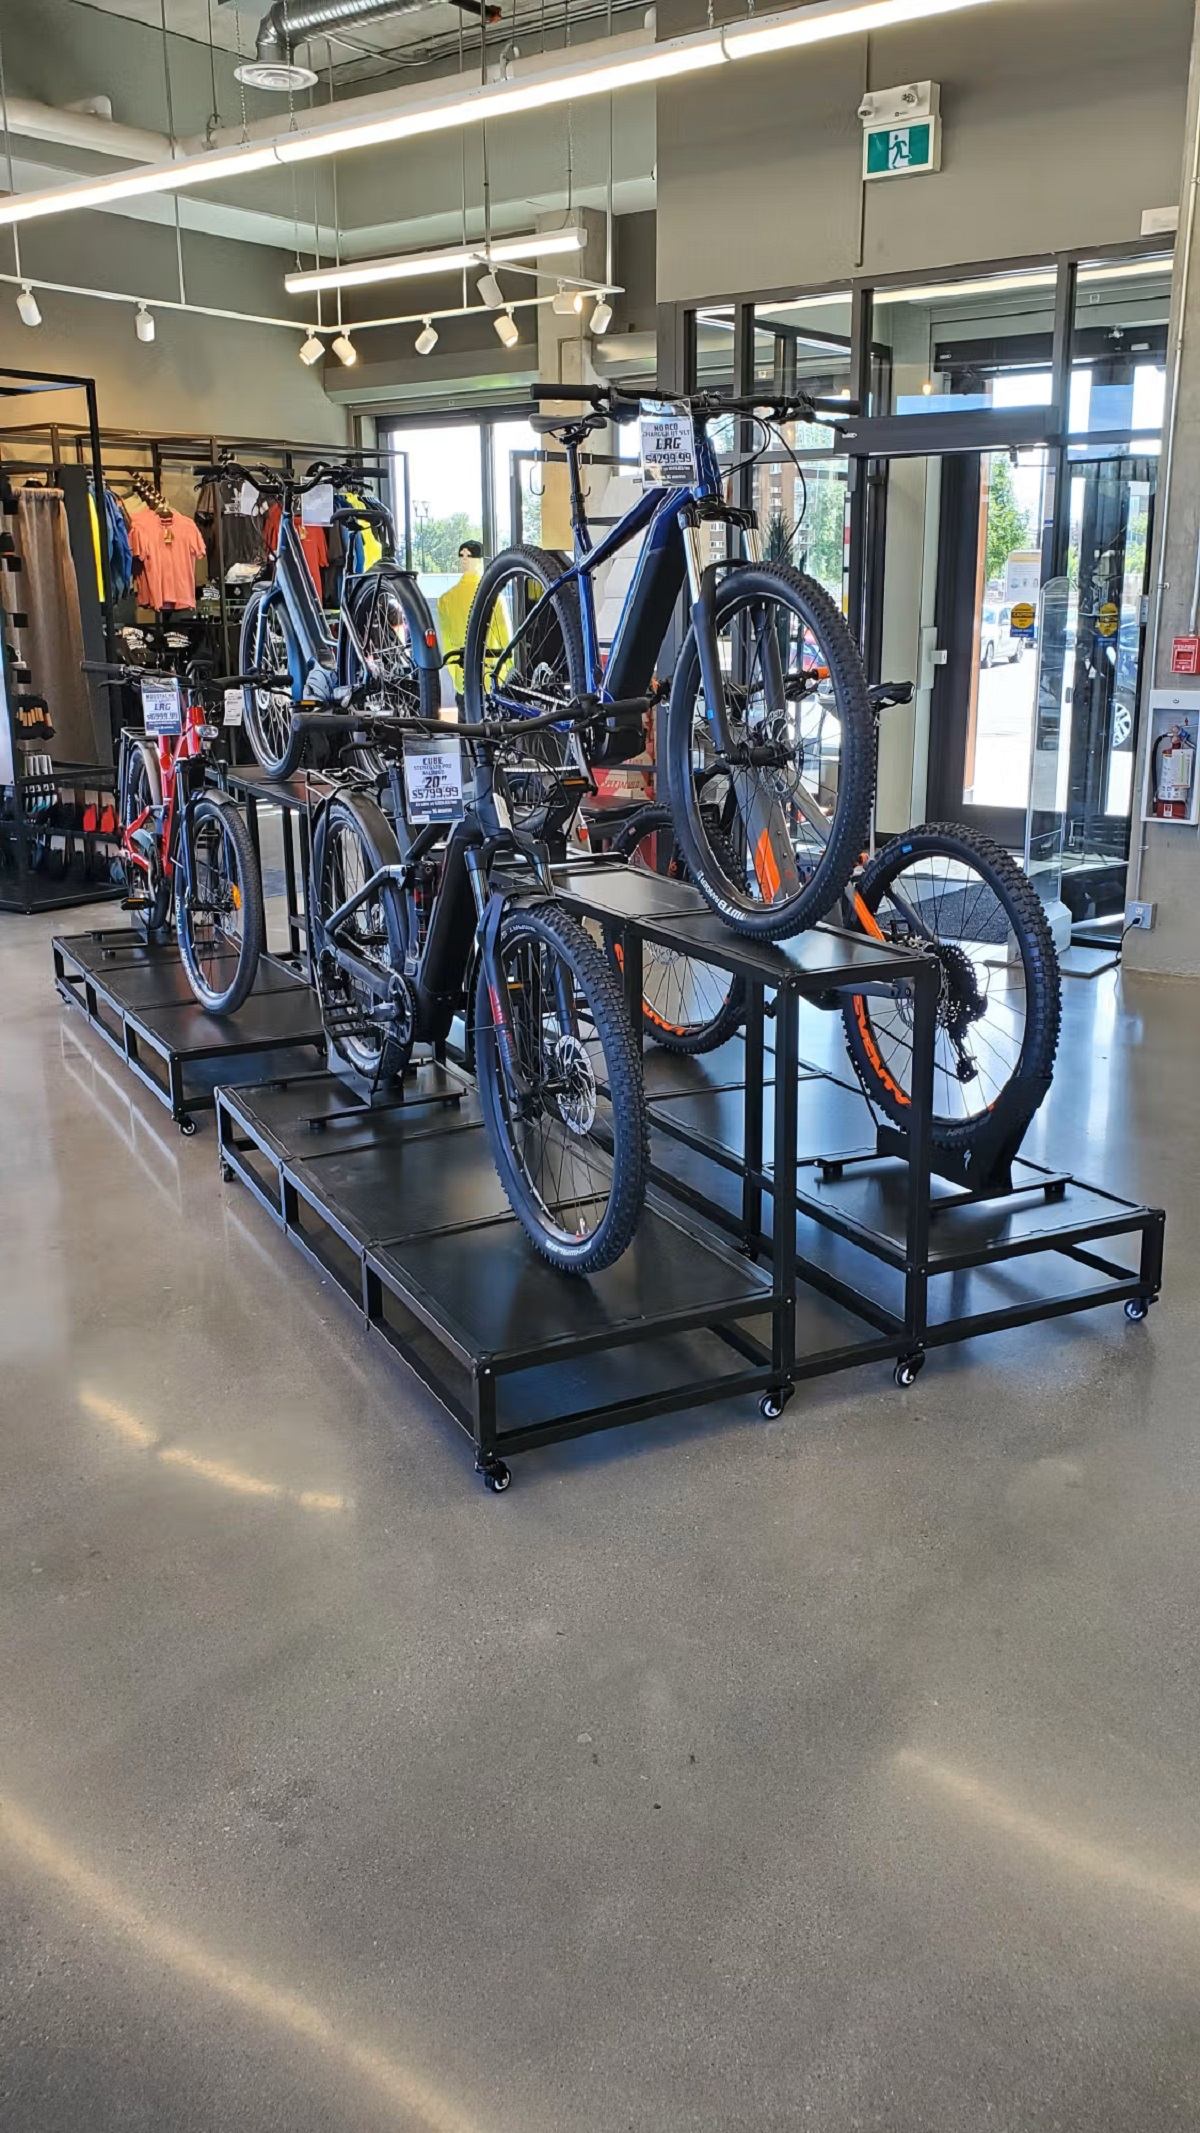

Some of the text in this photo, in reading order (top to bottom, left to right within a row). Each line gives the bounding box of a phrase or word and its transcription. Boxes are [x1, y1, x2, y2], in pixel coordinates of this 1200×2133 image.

[656, 437, 681, 450] LRG
[154, 703, 171, 711] LRG
[422, 756, 443, 766] CUBE
[424, 775, 448, 789] 20"
[412, 787, 459, 800] $5799.99
